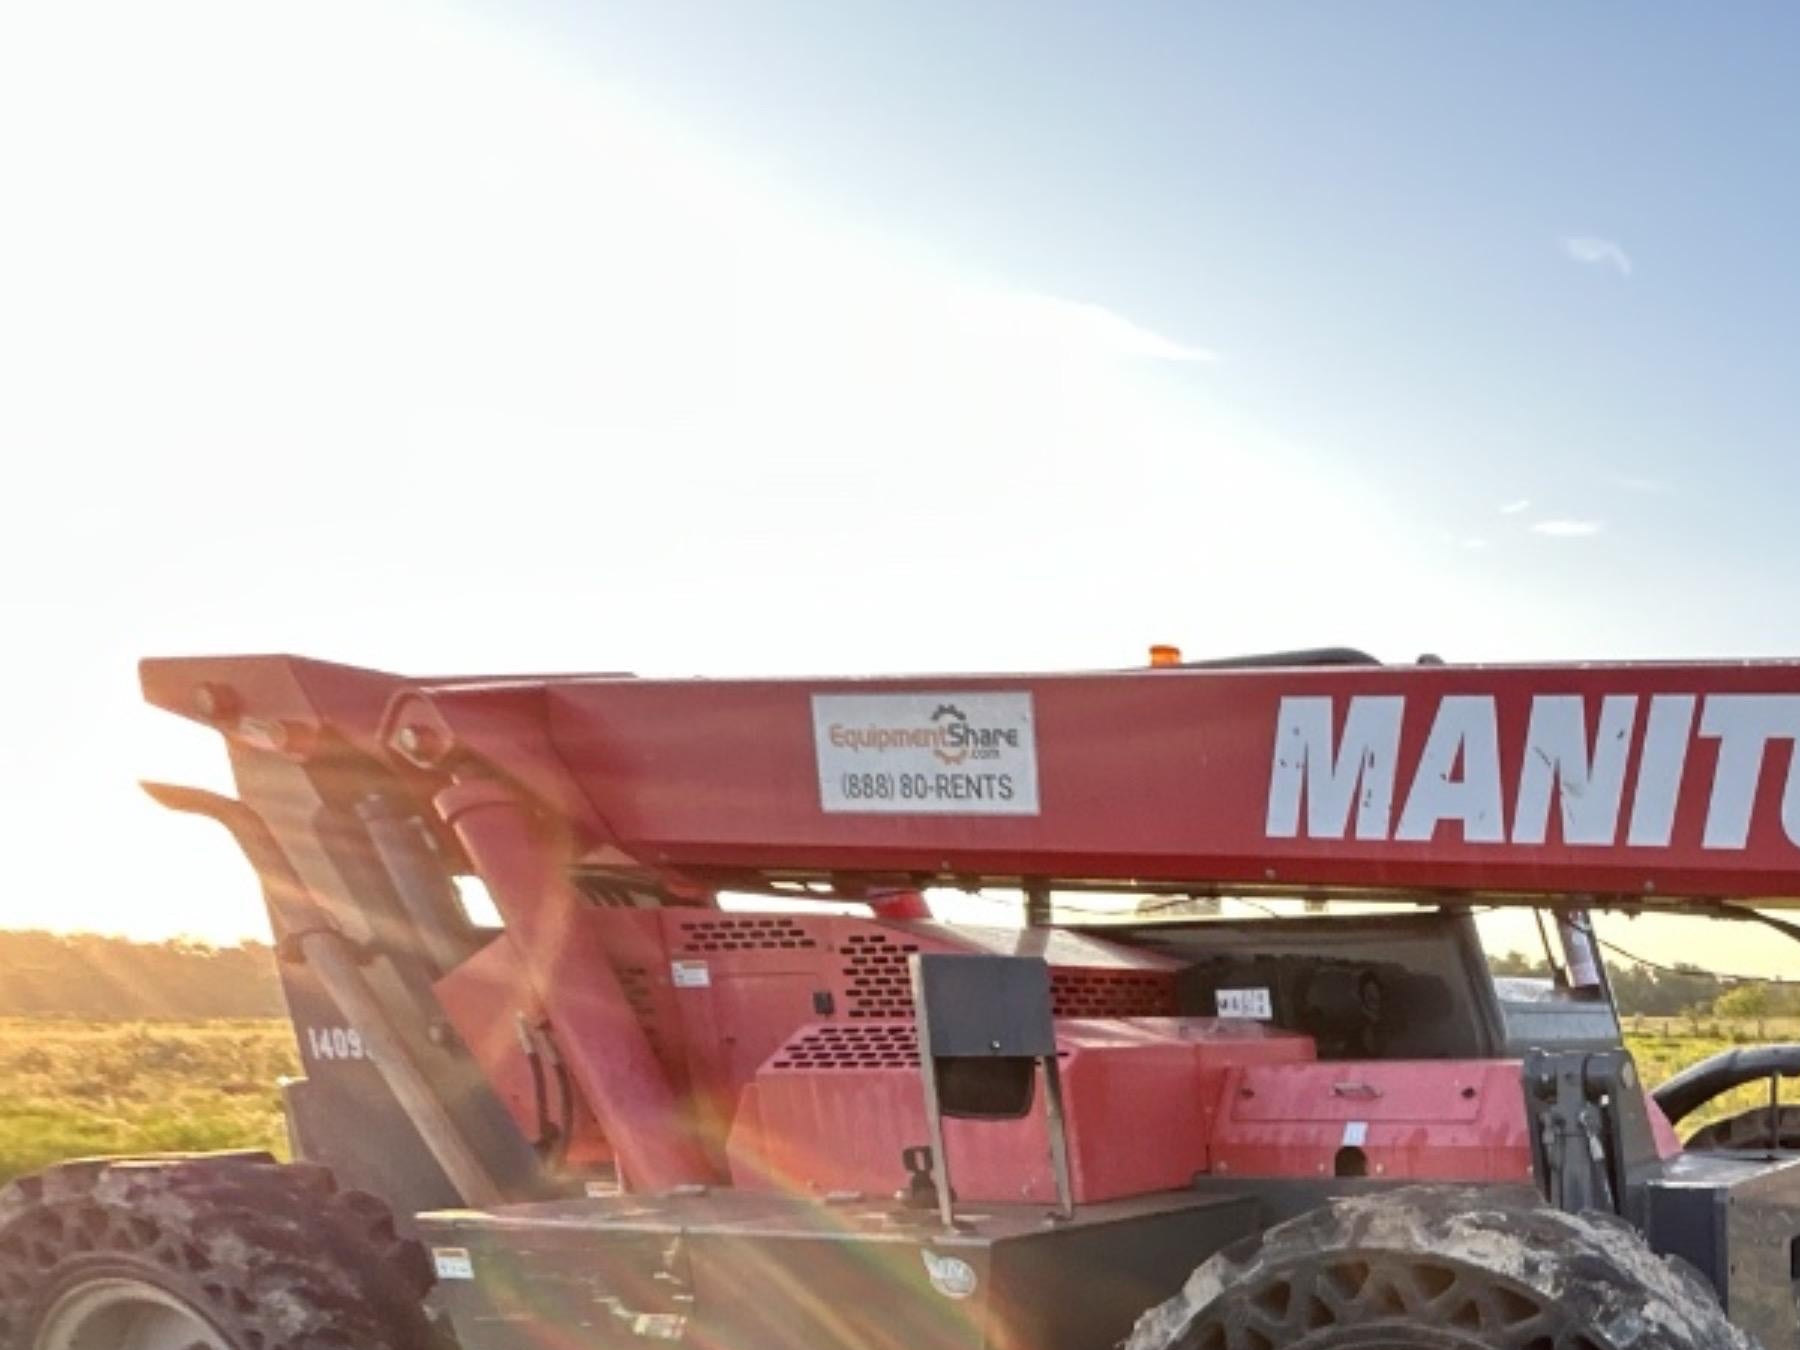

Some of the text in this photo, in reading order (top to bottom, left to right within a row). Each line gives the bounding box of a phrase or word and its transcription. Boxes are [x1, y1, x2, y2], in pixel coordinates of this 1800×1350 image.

[828, 722, 1019, 751] EquipmentShare
[841, 773, 1015, 800] (888) 80-RENTS
